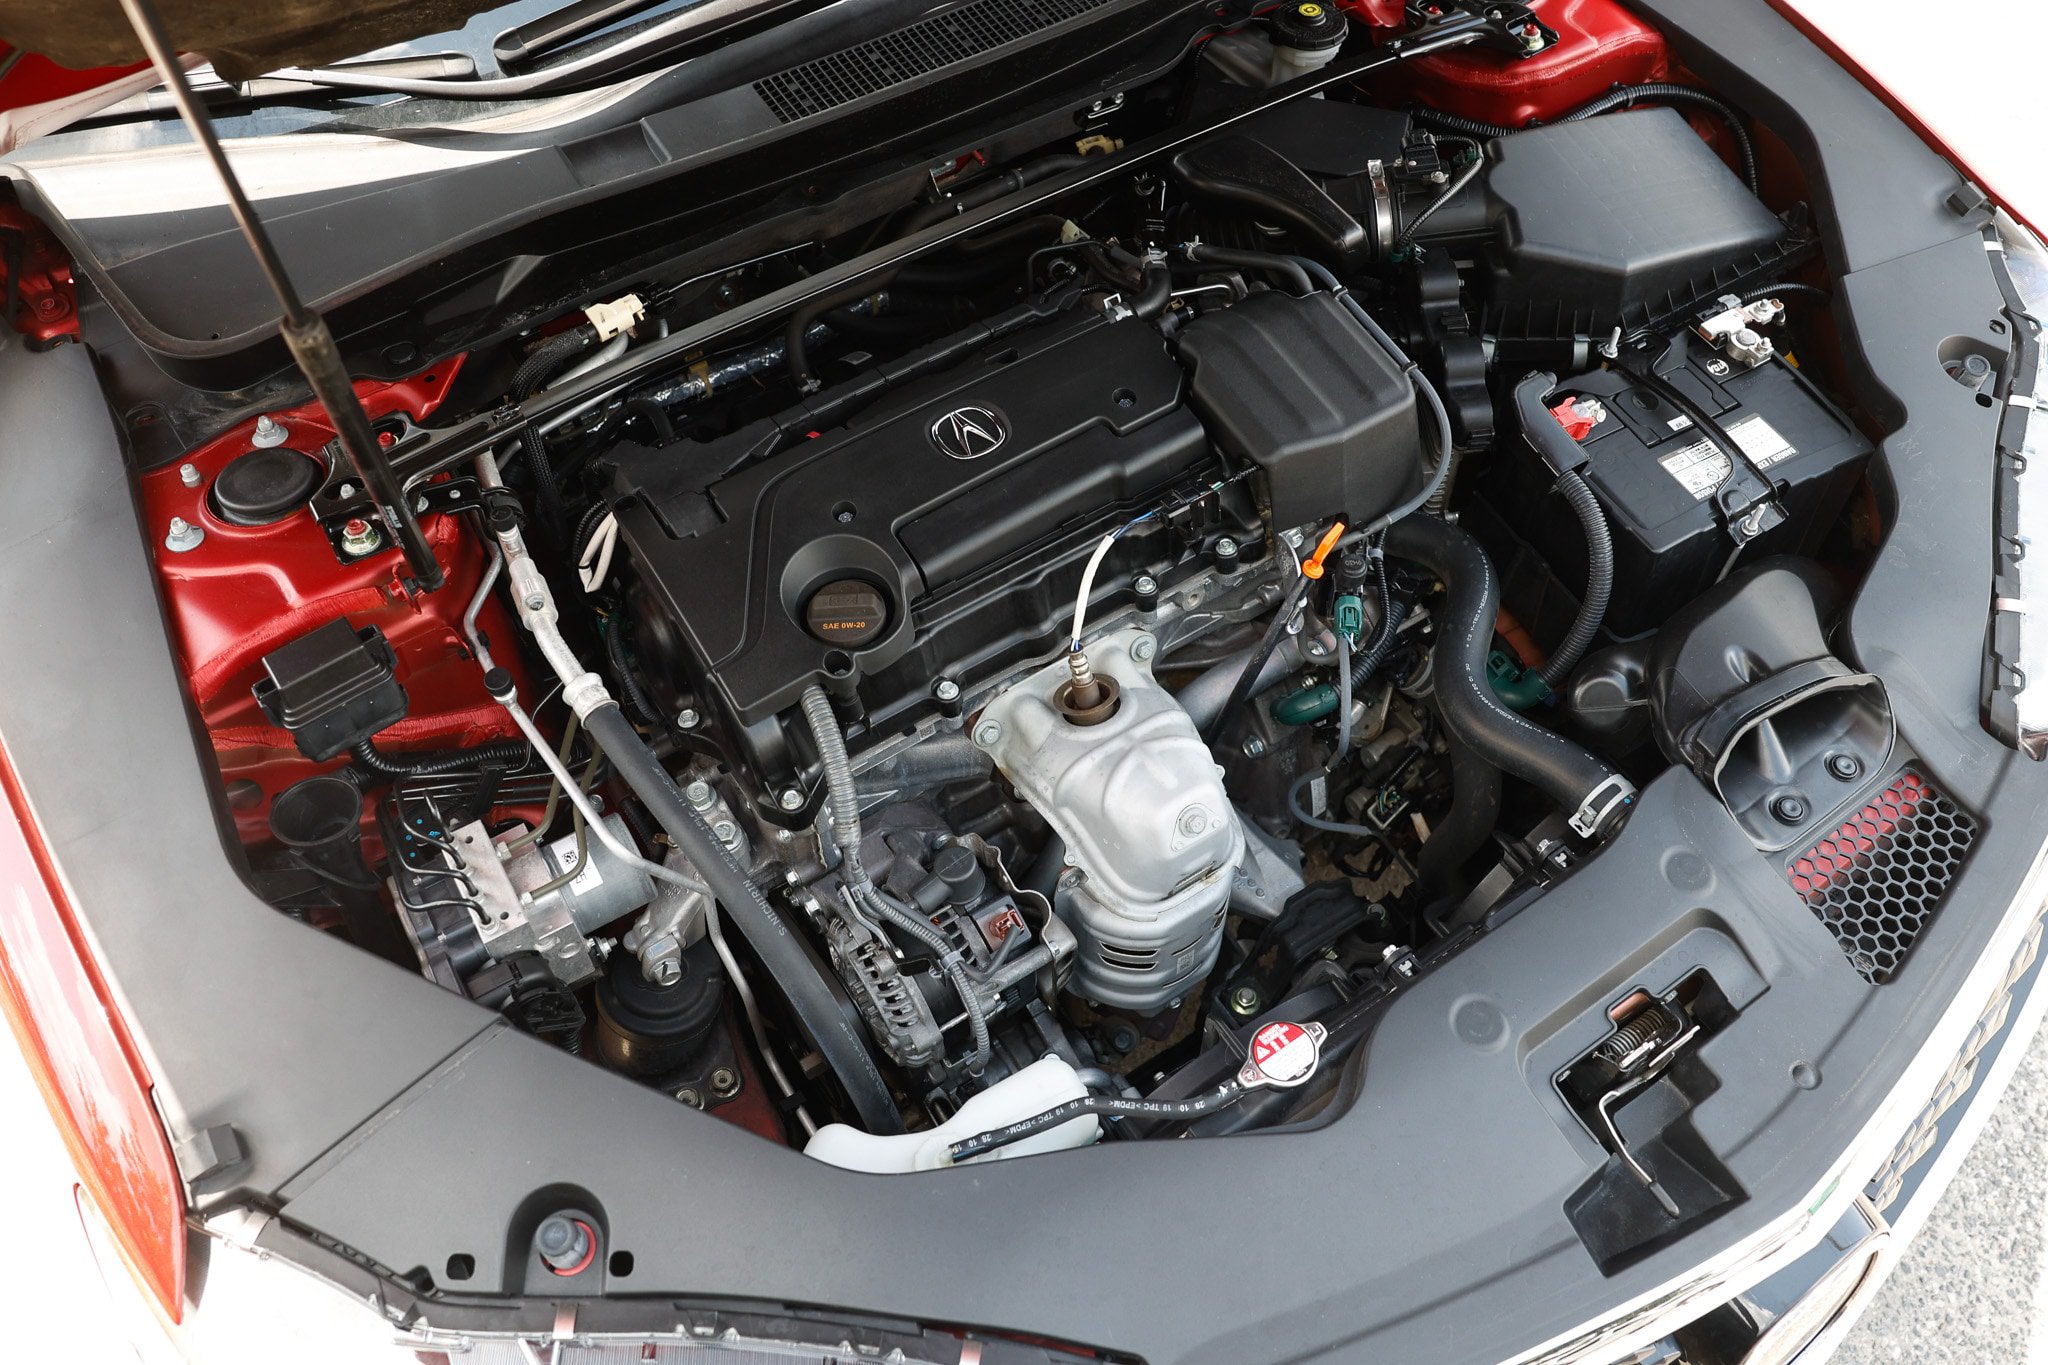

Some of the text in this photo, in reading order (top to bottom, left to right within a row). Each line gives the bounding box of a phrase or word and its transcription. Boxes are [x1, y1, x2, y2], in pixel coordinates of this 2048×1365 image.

[1773, 447, 1796, 463] DANGER
[1693, 486, 1716, 500] POISON
[840, 620, 865, 629] 0W-20
[1054, 1105, 1065, 1116] 19
[1143, 1102, 1159, 1111] TPC
[1179, 1103, 1189, 1112] 10
[1036, 1111, 1054, 1123] TPC
[967, 1137, 978, 1148] 10
